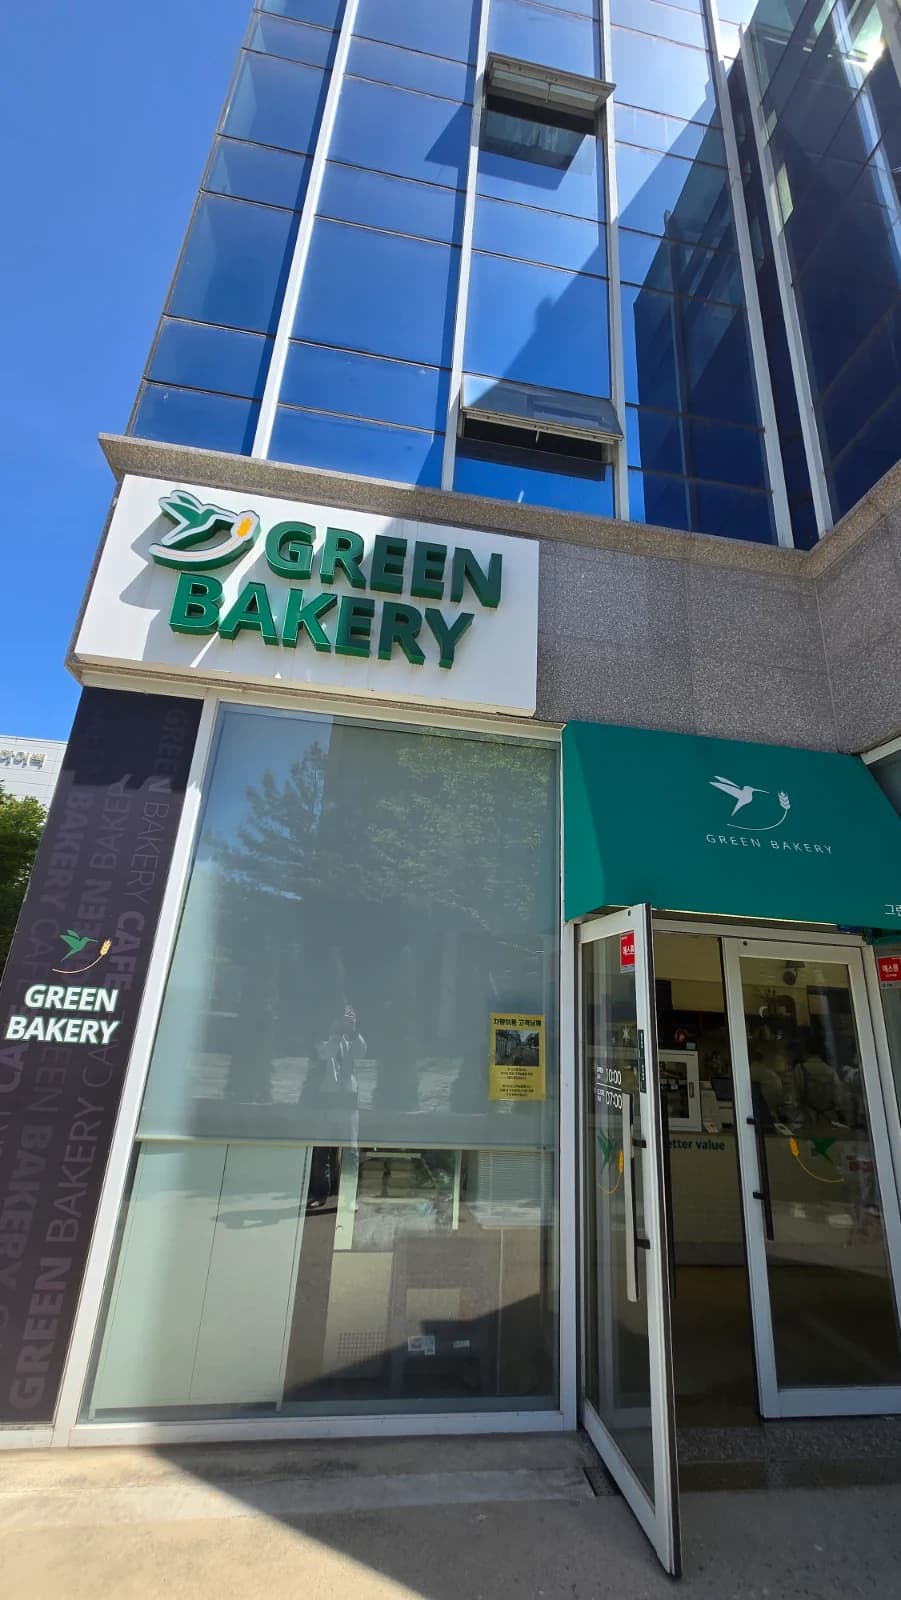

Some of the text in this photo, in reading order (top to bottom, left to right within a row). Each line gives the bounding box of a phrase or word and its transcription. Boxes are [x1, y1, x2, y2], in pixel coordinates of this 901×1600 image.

[264, 521, 503, 609] GREEN
[168, 572, 475, 670] BAKERY
[123, 801, 170, 905] BAKERY
[706, 834, 833, 855] GREEN BAKERY
[24, 983, 120, 1013] GREEN
[3, 1015, 121, 1046] BAKERY
[694, 1138, 725, 1151] value
[9, 1257, 74, 1409] GREEN
[46, 1097, 105, 1243] BAKERY
